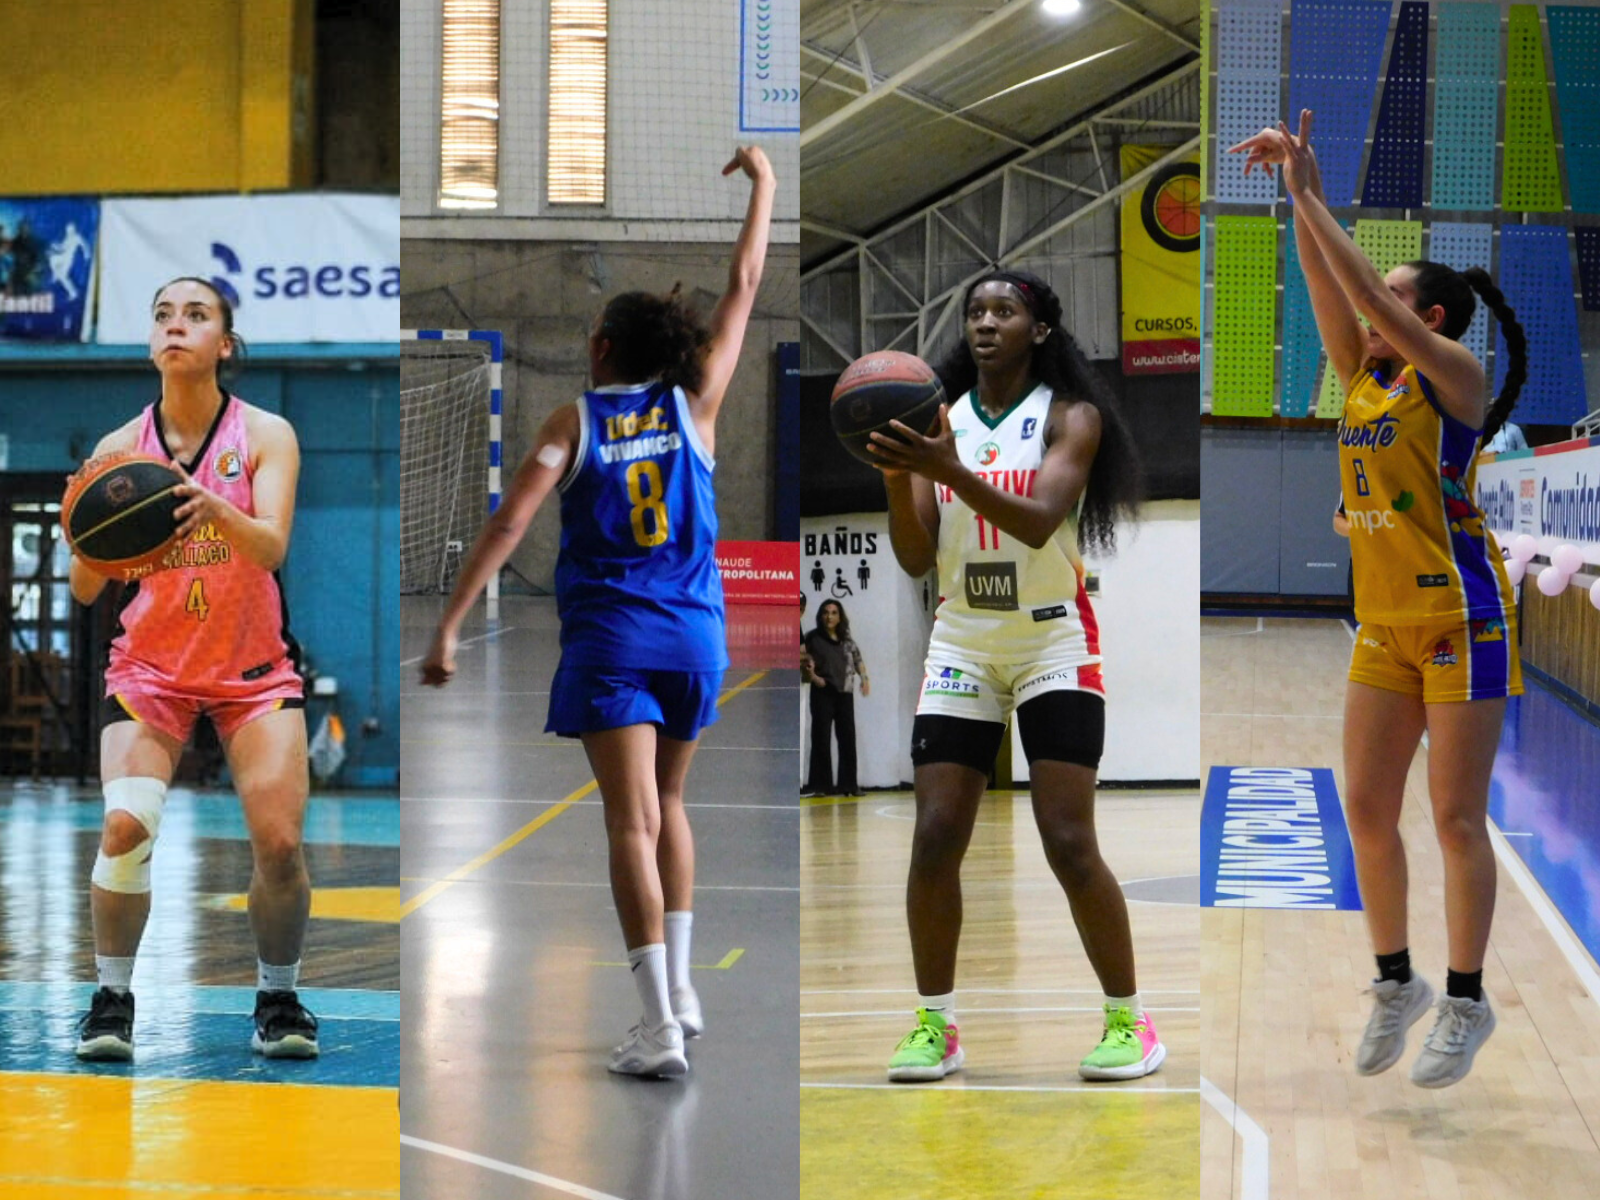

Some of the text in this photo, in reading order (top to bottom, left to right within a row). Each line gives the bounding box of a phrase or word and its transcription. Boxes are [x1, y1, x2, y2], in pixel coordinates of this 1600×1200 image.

[254, 266, 400, 299] saesa
[1135, 317, 1198, 332] CURSOS,
[599, 432, 682, 464] VIVANCO
[1352, 458, 1370, 496] 8
[626, 461, 668, 547] 8
[805, 526, 877, 556] BAÑOS
[186, 577, 210, 622] 4
[969, 575, 1012, 596] UVM
[926, 680, 980, 692] SPORTS
[1213, 767, 1336, 910] MUNICIPALIDAD
